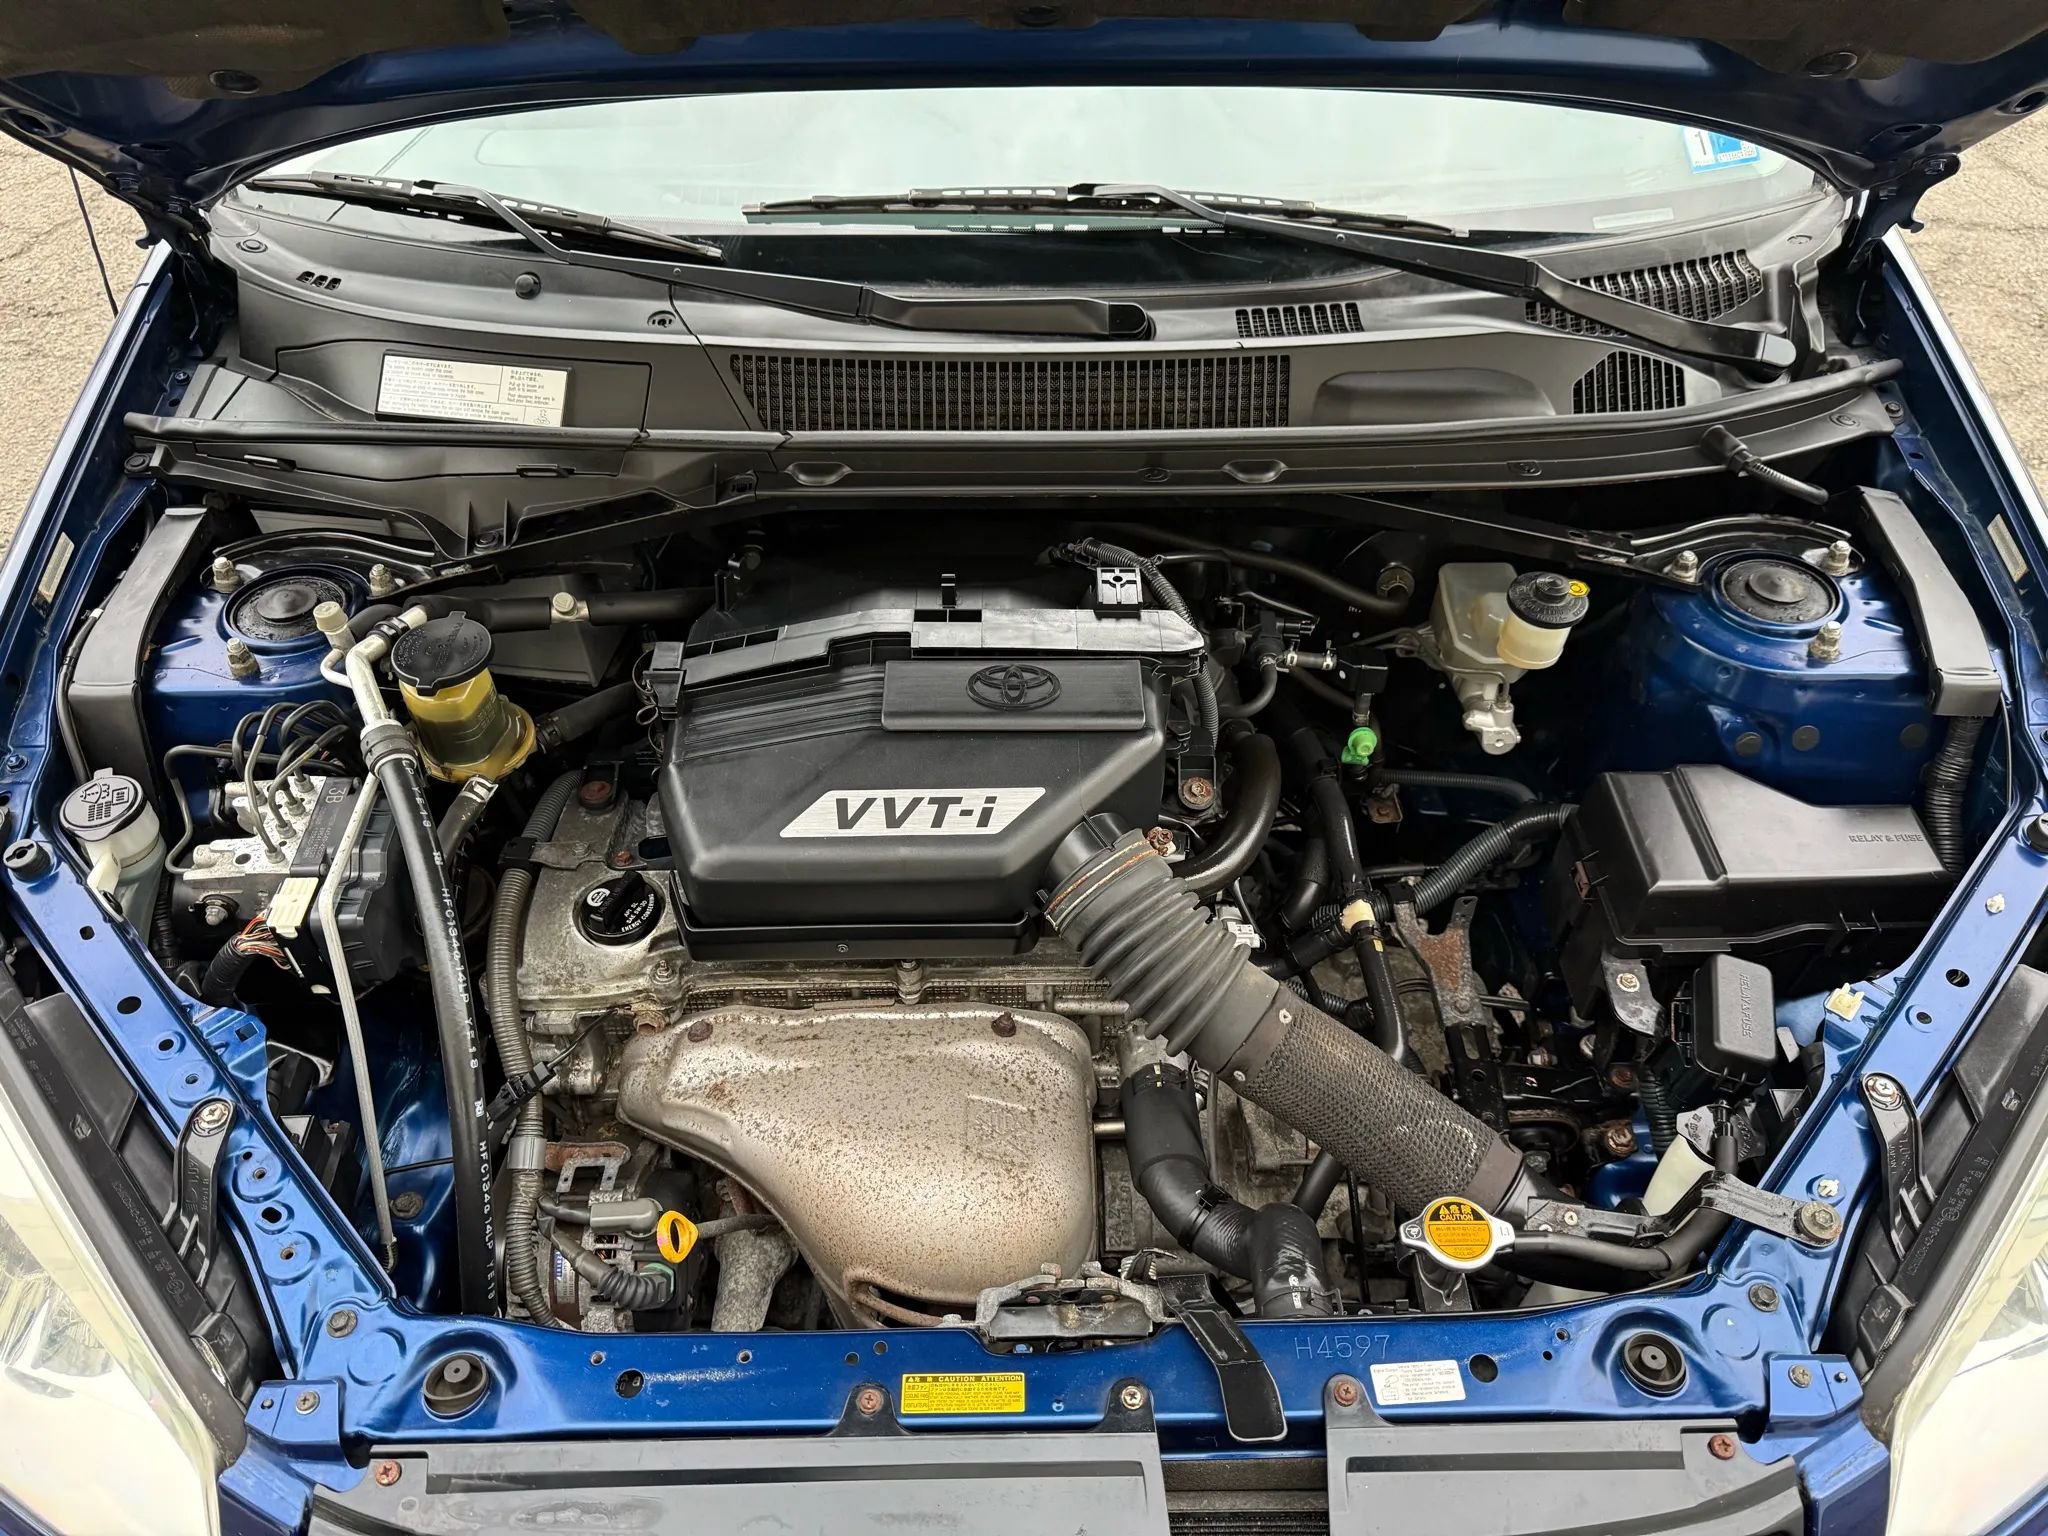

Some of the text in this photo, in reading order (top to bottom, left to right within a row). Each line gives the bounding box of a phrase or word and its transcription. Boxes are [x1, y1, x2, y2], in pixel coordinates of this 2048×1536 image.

[326, 788, 346, 803] 3B
[836, 796, 998, 830] VVT-i
[1848, 834, 1884, 842] RELAY
[1895, 834, 1924, 842] FUSE
[621, 894, 654, 932] ENERGY CONSERVING
[626, 914, 636, 924] SAE
[1739, 974, 1752, 1004] RELAY
[1742, 1011, 1752, 1038] FUSE
[1450, 1205, 1472, 1214] 危険
[1294, 1334, 1390, 1360] H4597
